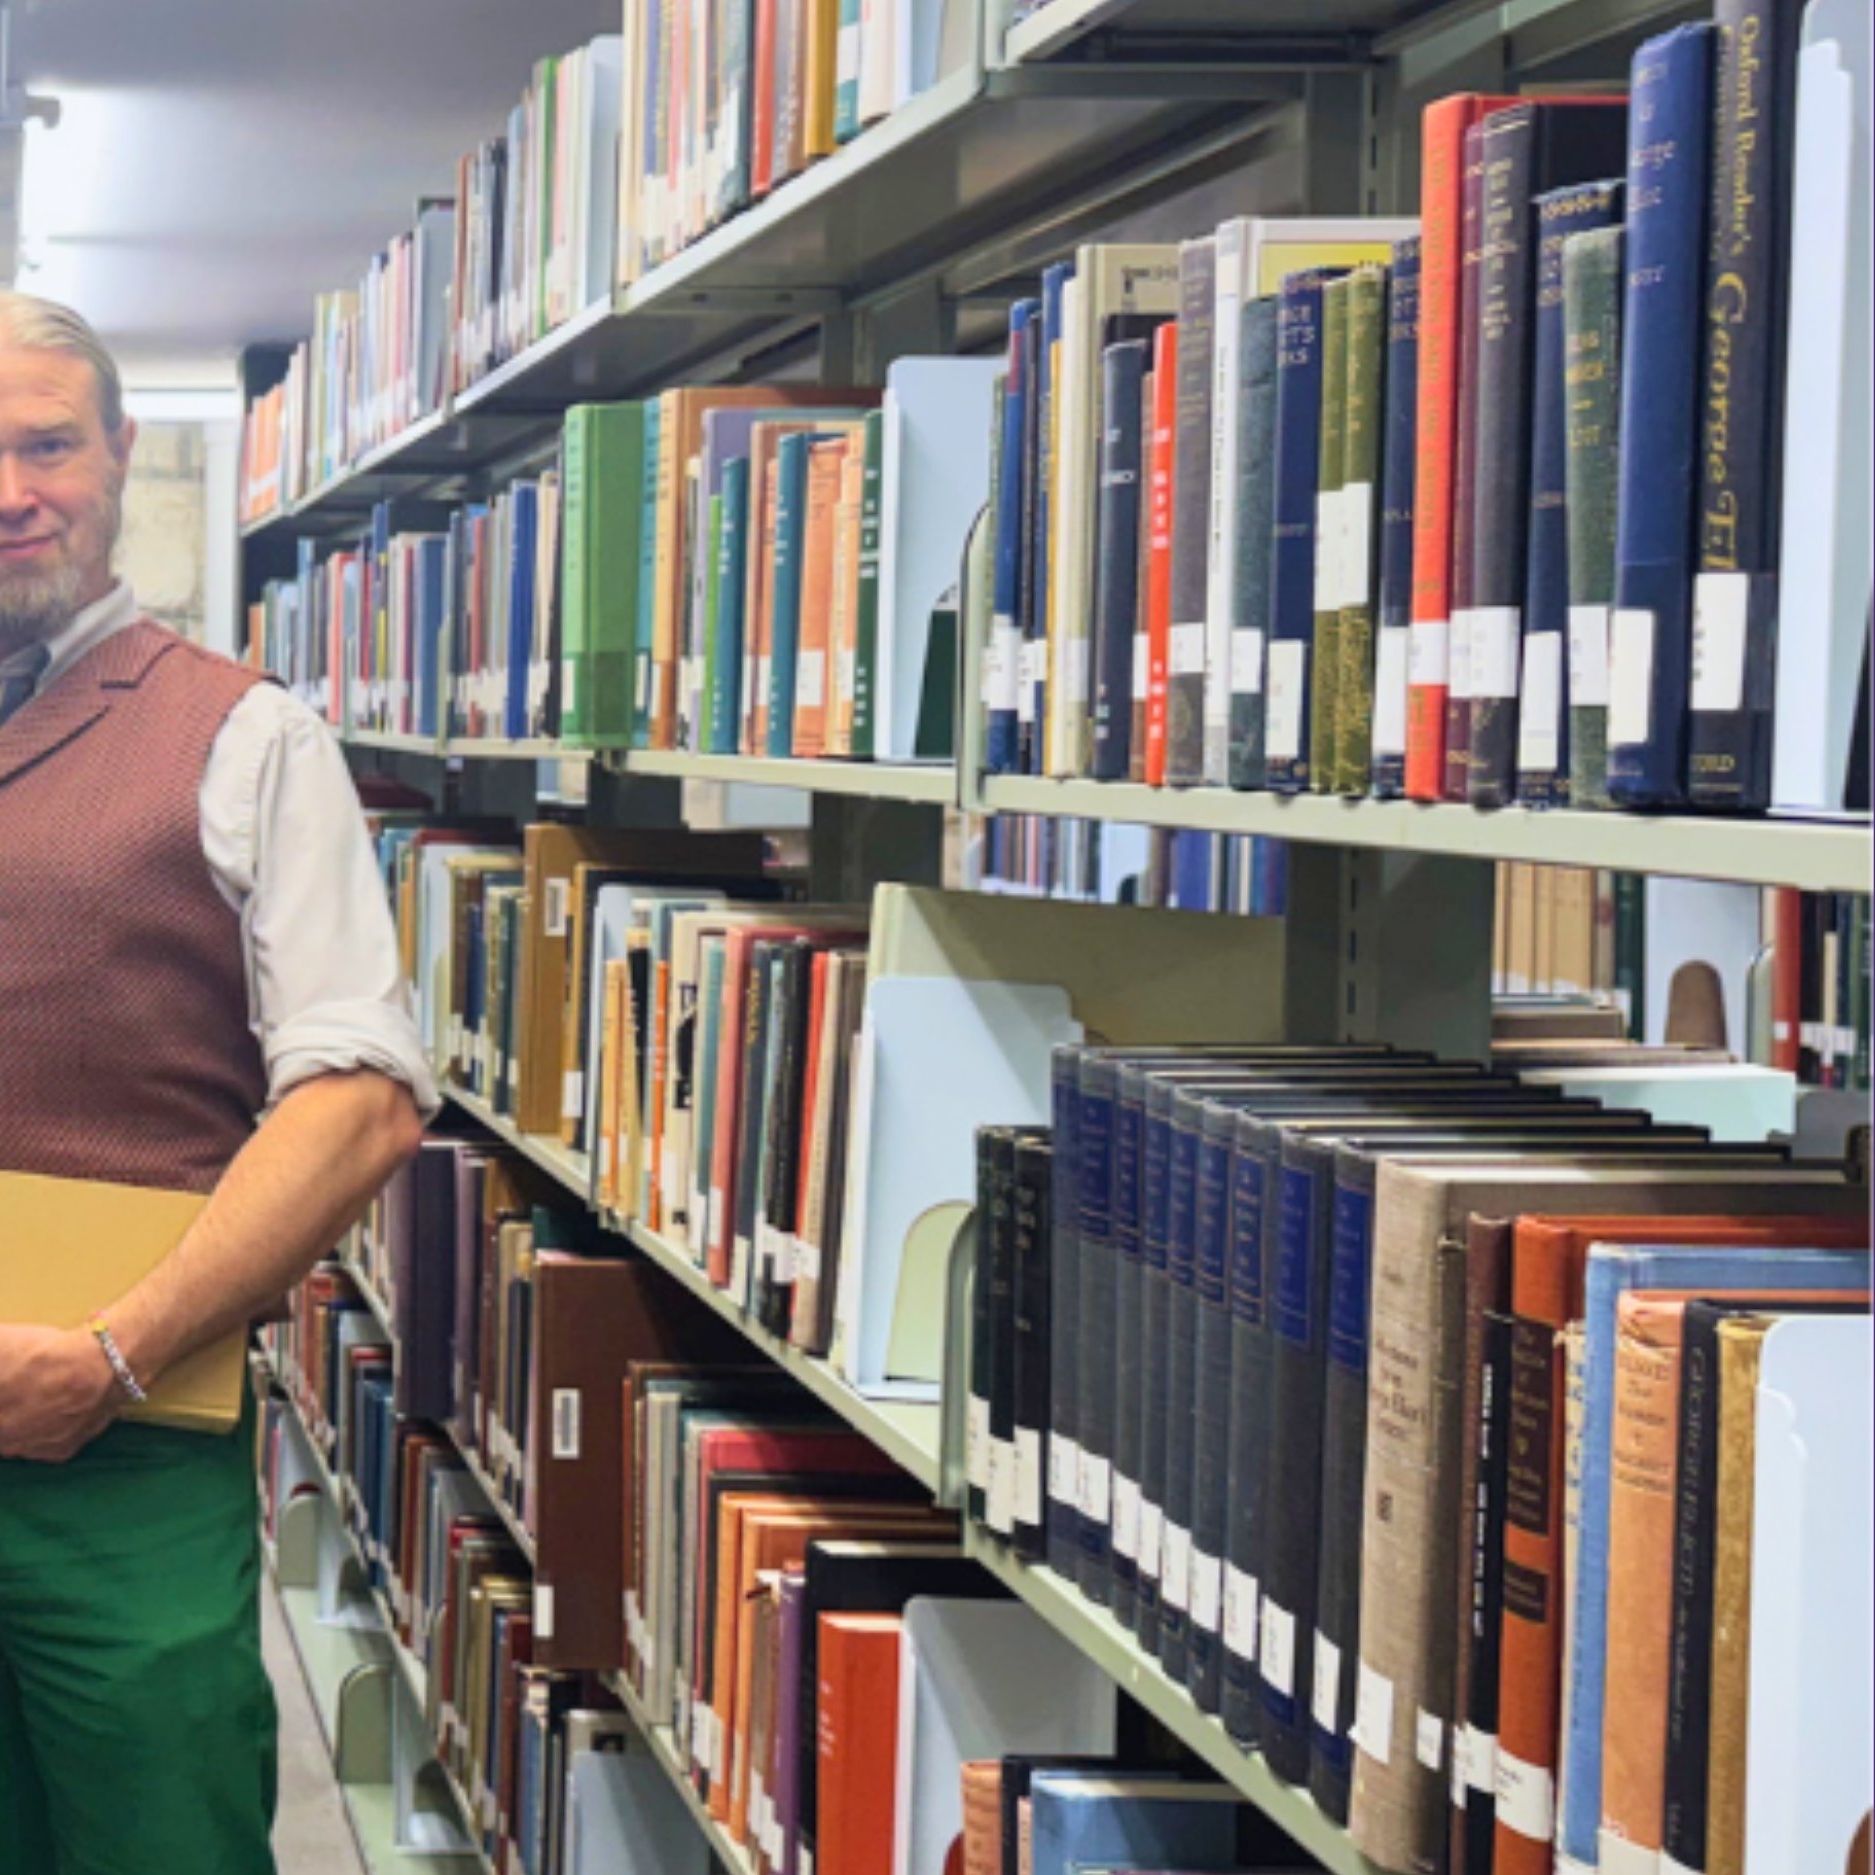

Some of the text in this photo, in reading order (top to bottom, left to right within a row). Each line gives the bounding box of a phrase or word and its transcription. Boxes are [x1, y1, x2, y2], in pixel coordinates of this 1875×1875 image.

[1731, 14, 1760, 257] Oxford Reader's
[1707, 271, 1748, 484] George
